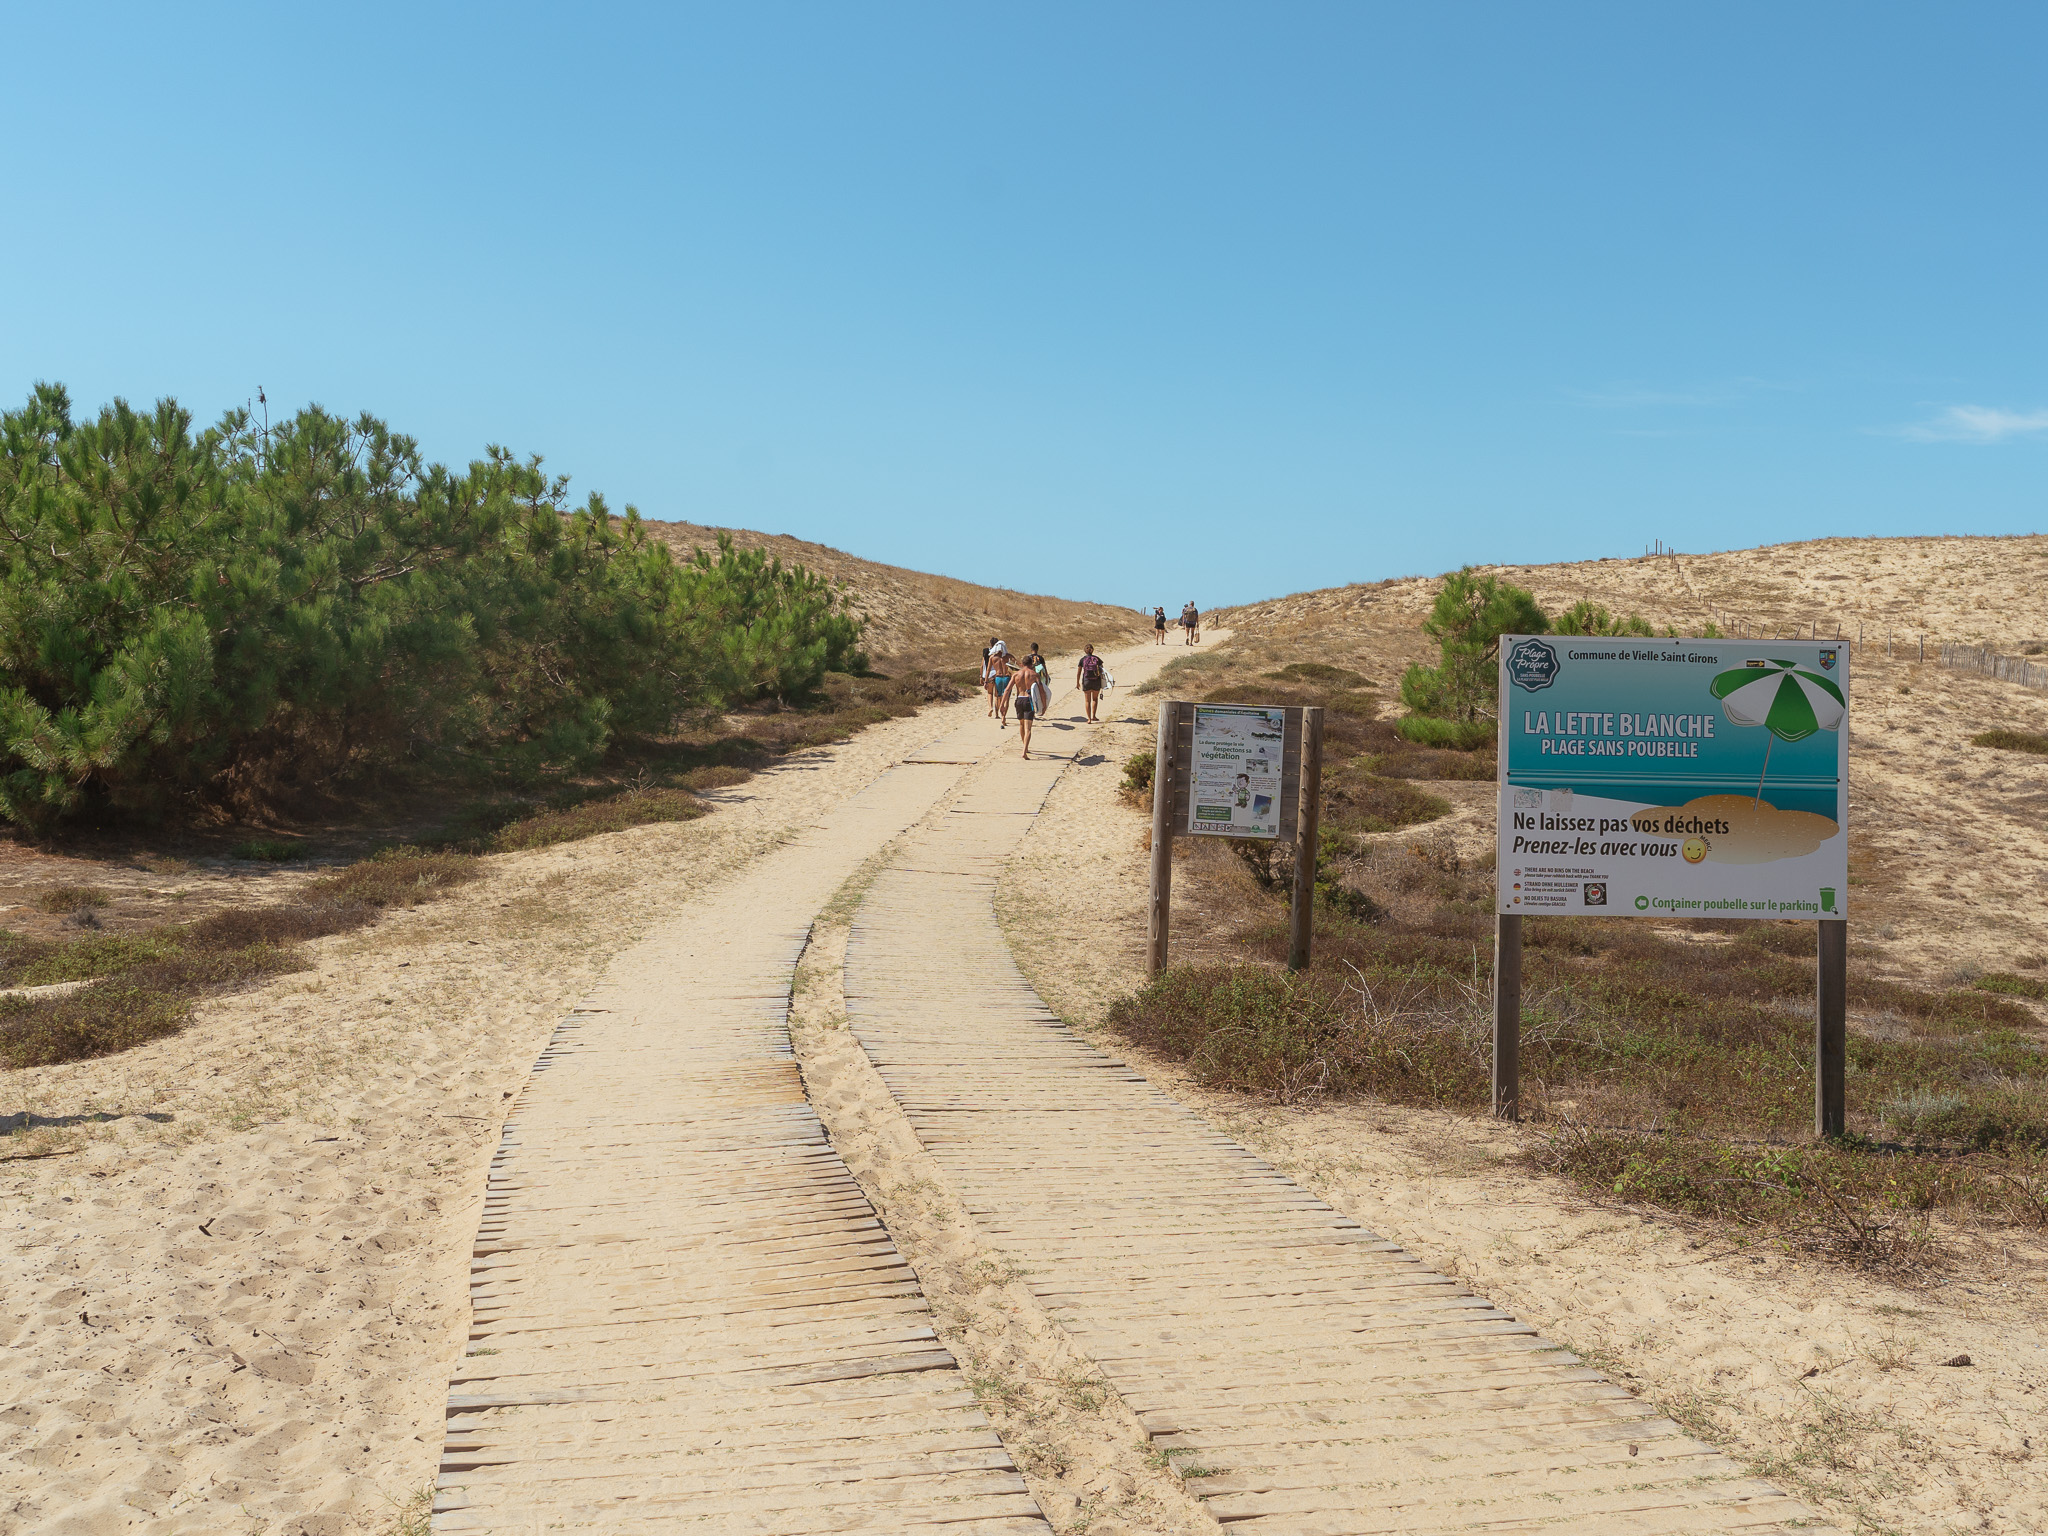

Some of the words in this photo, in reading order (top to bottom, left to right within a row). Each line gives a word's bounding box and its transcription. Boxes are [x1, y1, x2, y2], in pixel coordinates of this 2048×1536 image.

[1519, 648, 1546, 661] Plage
[1568, 650, 1616, 661] Commune
[1618, 650, 1630, 661] de
[1632, 651, 1659, 662] Vielle
[1661, 652, 1685, 662] Saint
[1687, 652, 1718, 664] Girons
[1515, 659, 1549, 671] Propre
[1524, 711, 1549, 734] LA
[1555, 712, 1614, 736] LETTE
[1619, 713, 1715, 738] BLANCHE
[1201, 751, 1239, 760] végétation
[1541, 739, 1585, 754] PLAGE
[1588, 740, 1624, 756] SANS
[1627, 741, 1698, 758] POUBELLE
[1513, 812, 1535, 830] Ne
[1540, 813, 1595, 831] laissez
[1599, 817, 1628, 835] pas
[1632, 819, 1660, 833] vos
[1663, 815, 1729, 834] déchets
[1513, 836, 1597, 855] Prenez-les
[1600, 841, 1637, 856] avec
[1640, 842, 1677, 857] vous
[1700, 835, 1712, 851] MERCI
[1652, 897, 1701, 910] Container
[1704, 899, 1747, 912] poubelle
[1750, 902, 1765, 911] sur
[1768, 900, 1777, 911] le
[1779, 901, 1818, 913] parking
